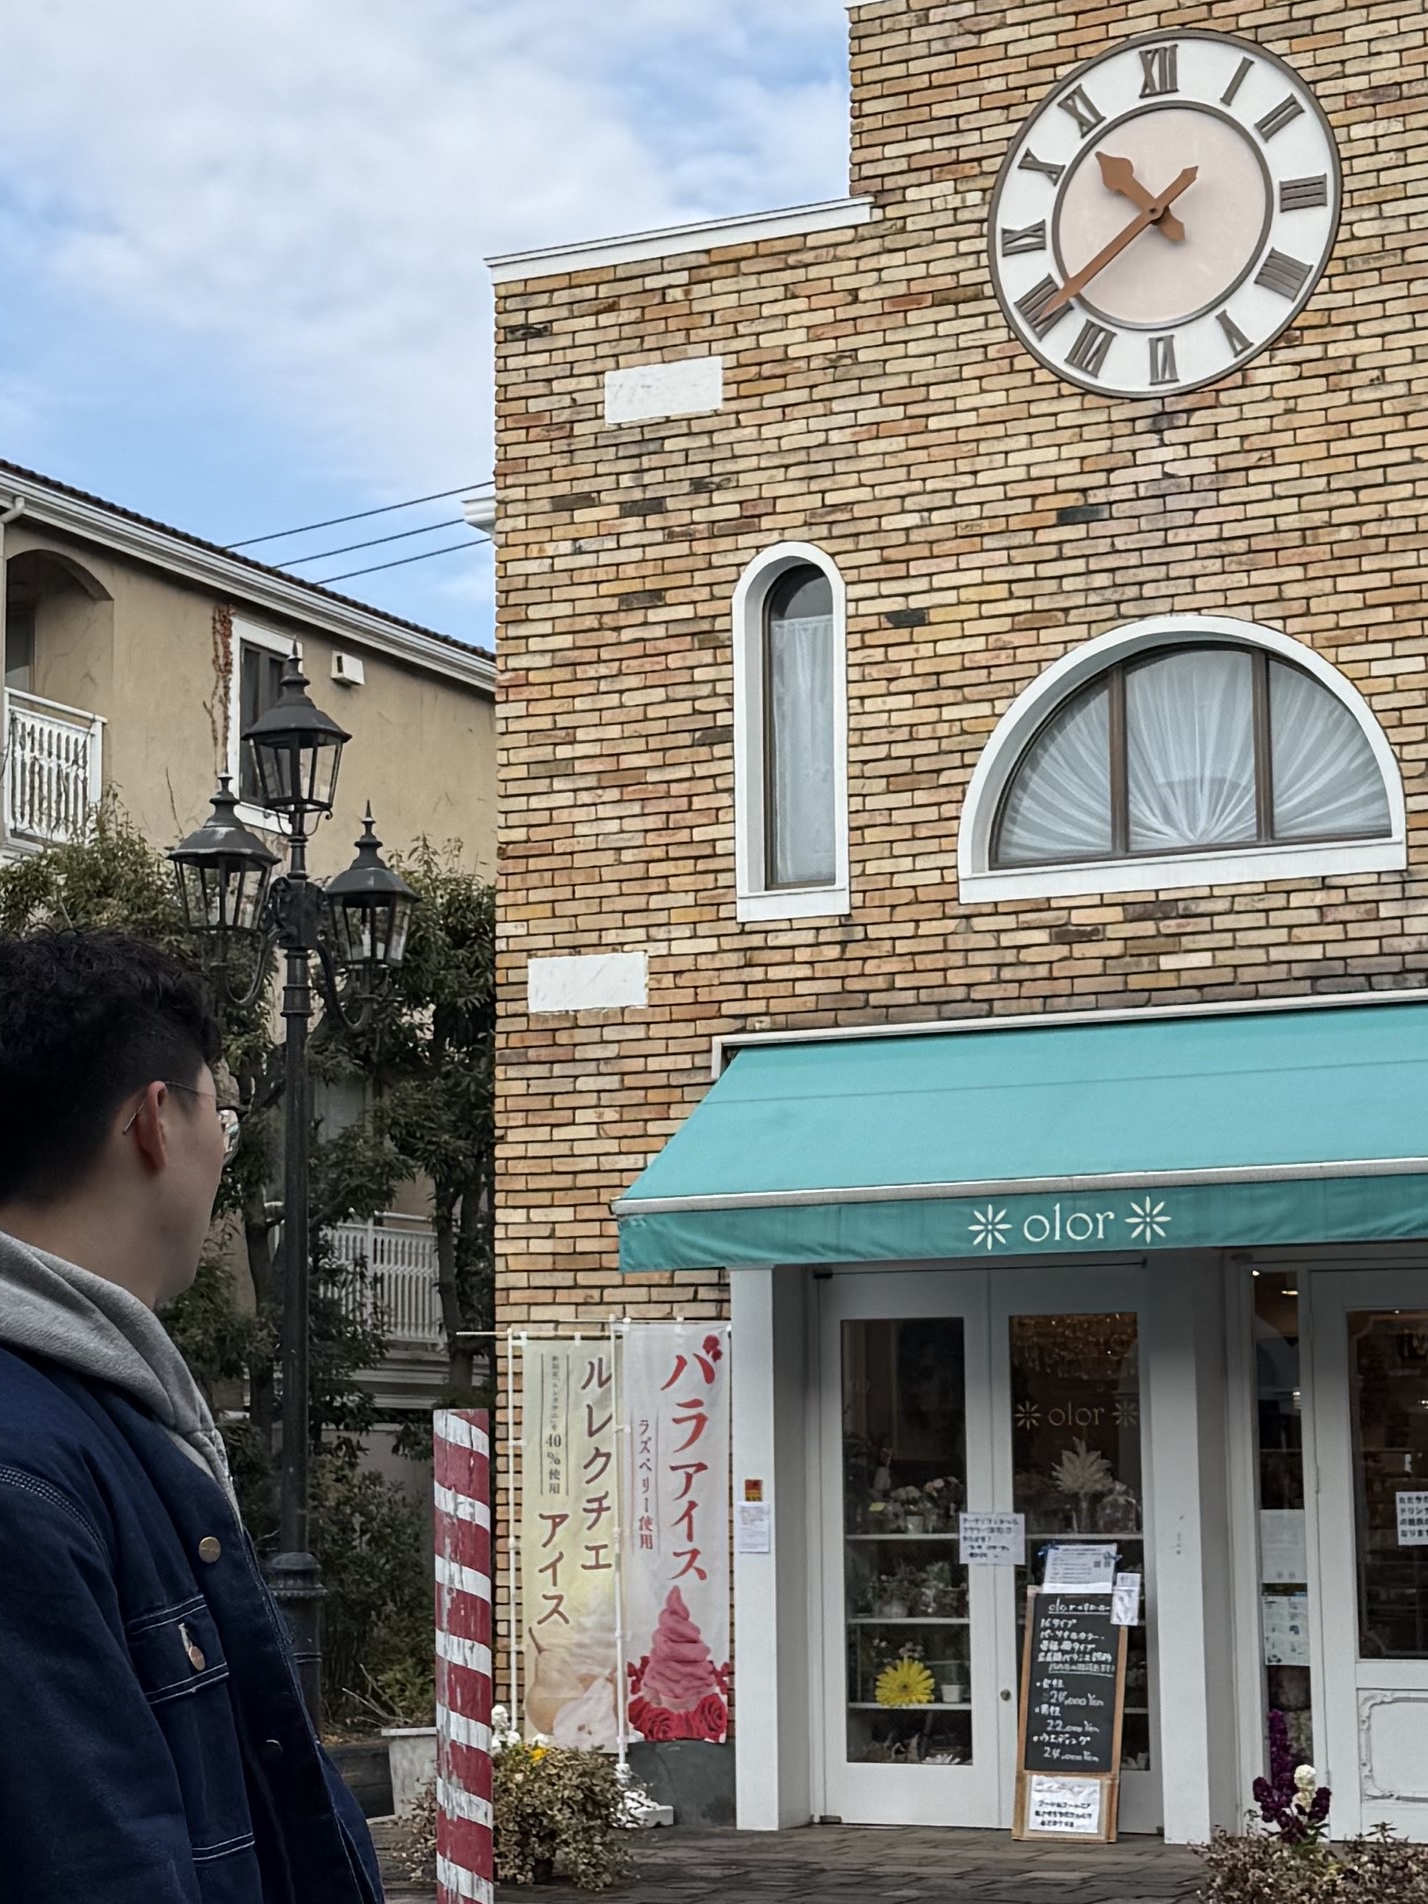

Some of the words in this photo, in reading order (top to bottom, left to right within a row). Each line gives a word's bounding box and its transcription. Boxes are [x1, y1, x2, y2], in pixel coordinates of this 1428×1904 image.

[1138, 43, 1179, 99] XII
[1219, 56, 1255, 106] I
[1056, 83, 1106, 138] XI
[1253, 92, 1304, 142] II
[1017, 146, 1066, 187] X
[1279, 173, 1328, 213] III
[1000, 219, 1047, 258] IX
[1013, 272, 1075, 343] VIII
[1063, 318, 1118, 379] VII
[1215, 308, 1255, 358] V
[1148, 333, 1180, 386] VI
[1023, 1202, 1116, 1242] olor
[1047, 1400, 1105, 1426] olor
[659, 1335, 723, 1582] バラアイス
[537, 1512, 570, 1626] アイス
